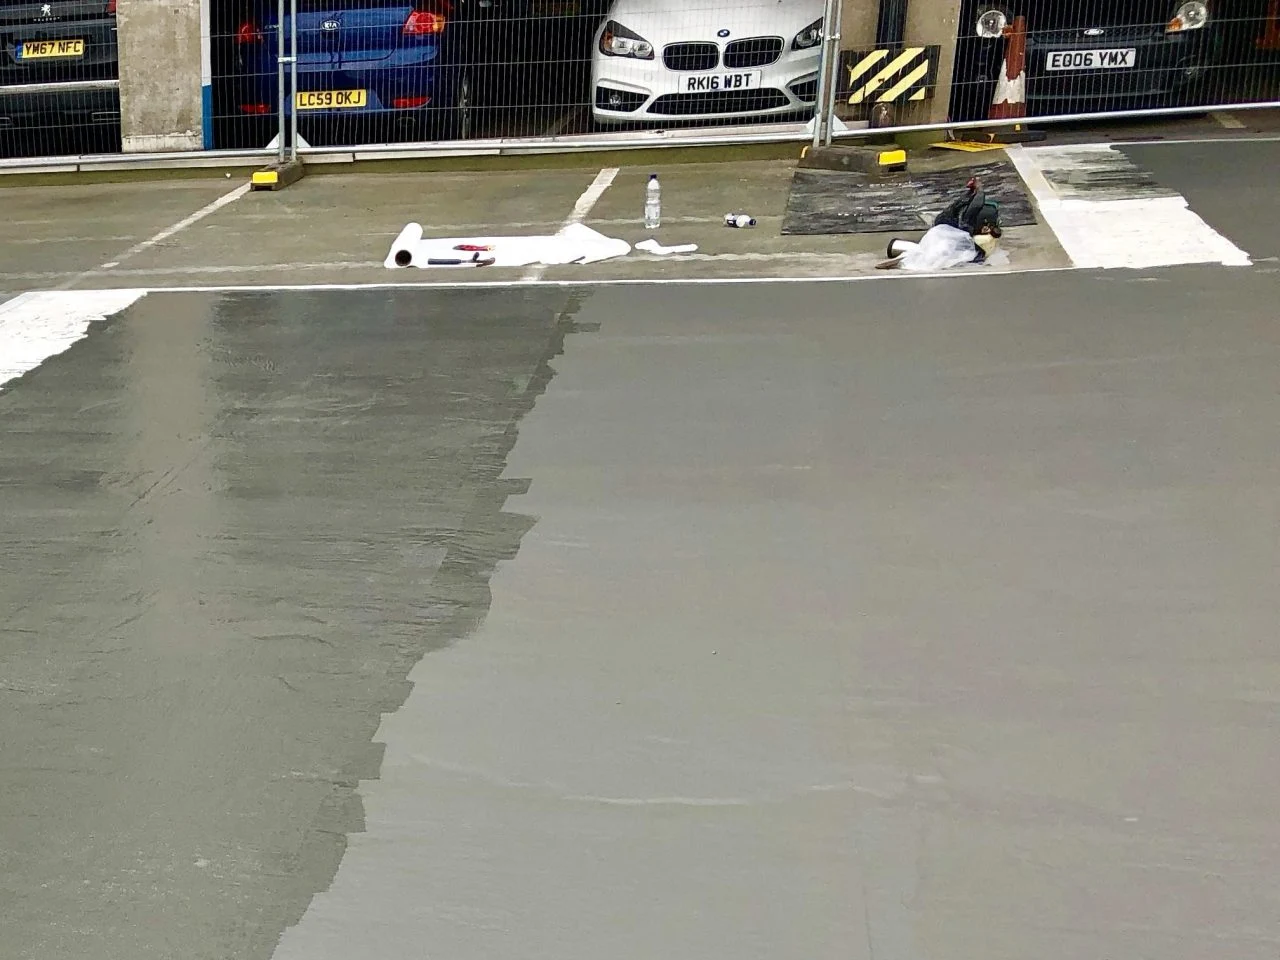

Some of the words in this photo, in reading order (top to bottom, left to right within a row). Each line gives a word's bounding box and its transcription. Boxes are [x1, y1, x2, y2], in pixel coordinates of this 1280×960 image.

[58, 41, 82, 53] NFC
[1099, 51, 1129, 66] YMX
[687, 76, 720, 91] RK16
[724, 73, 752, 89] WBT
[299, 92, 332, 107] LC59
[336, 91, 361, 105] OKJ
